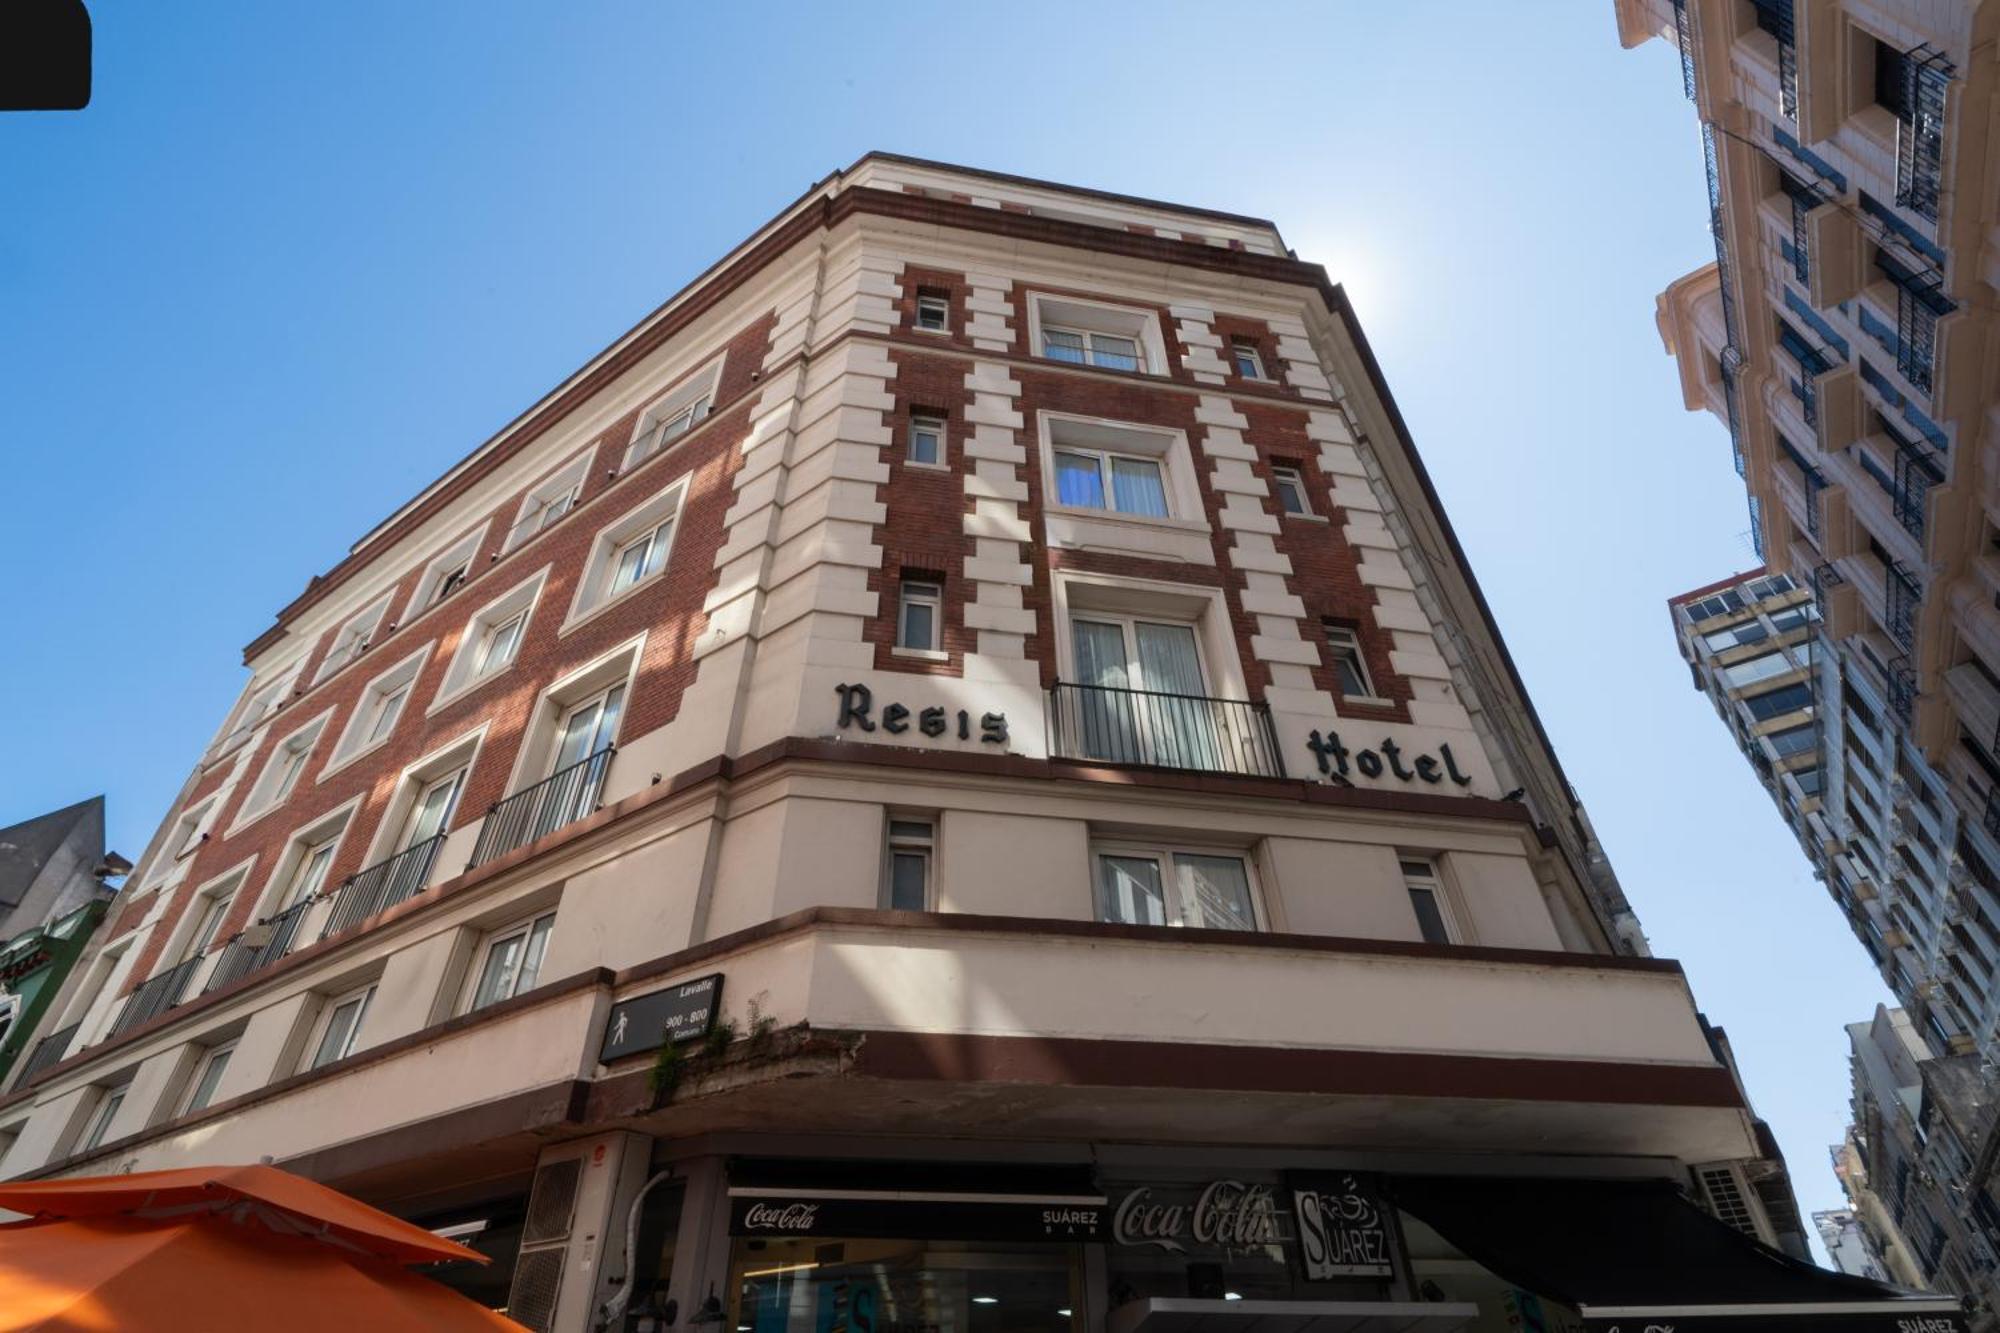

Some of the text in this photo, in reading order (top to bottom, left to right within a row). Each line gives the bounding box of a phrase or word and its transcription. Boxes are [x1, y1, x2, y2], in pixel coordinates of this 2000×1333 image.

[1307, 729, 1473, 787] Hotel
[681, 980, 712, 998] Lavalle
[667, 1014, 683, 1029] 900
[690, 1008, 708, 1024] 800
[1042, 1208, 1098, 1225] SUÁREZ
